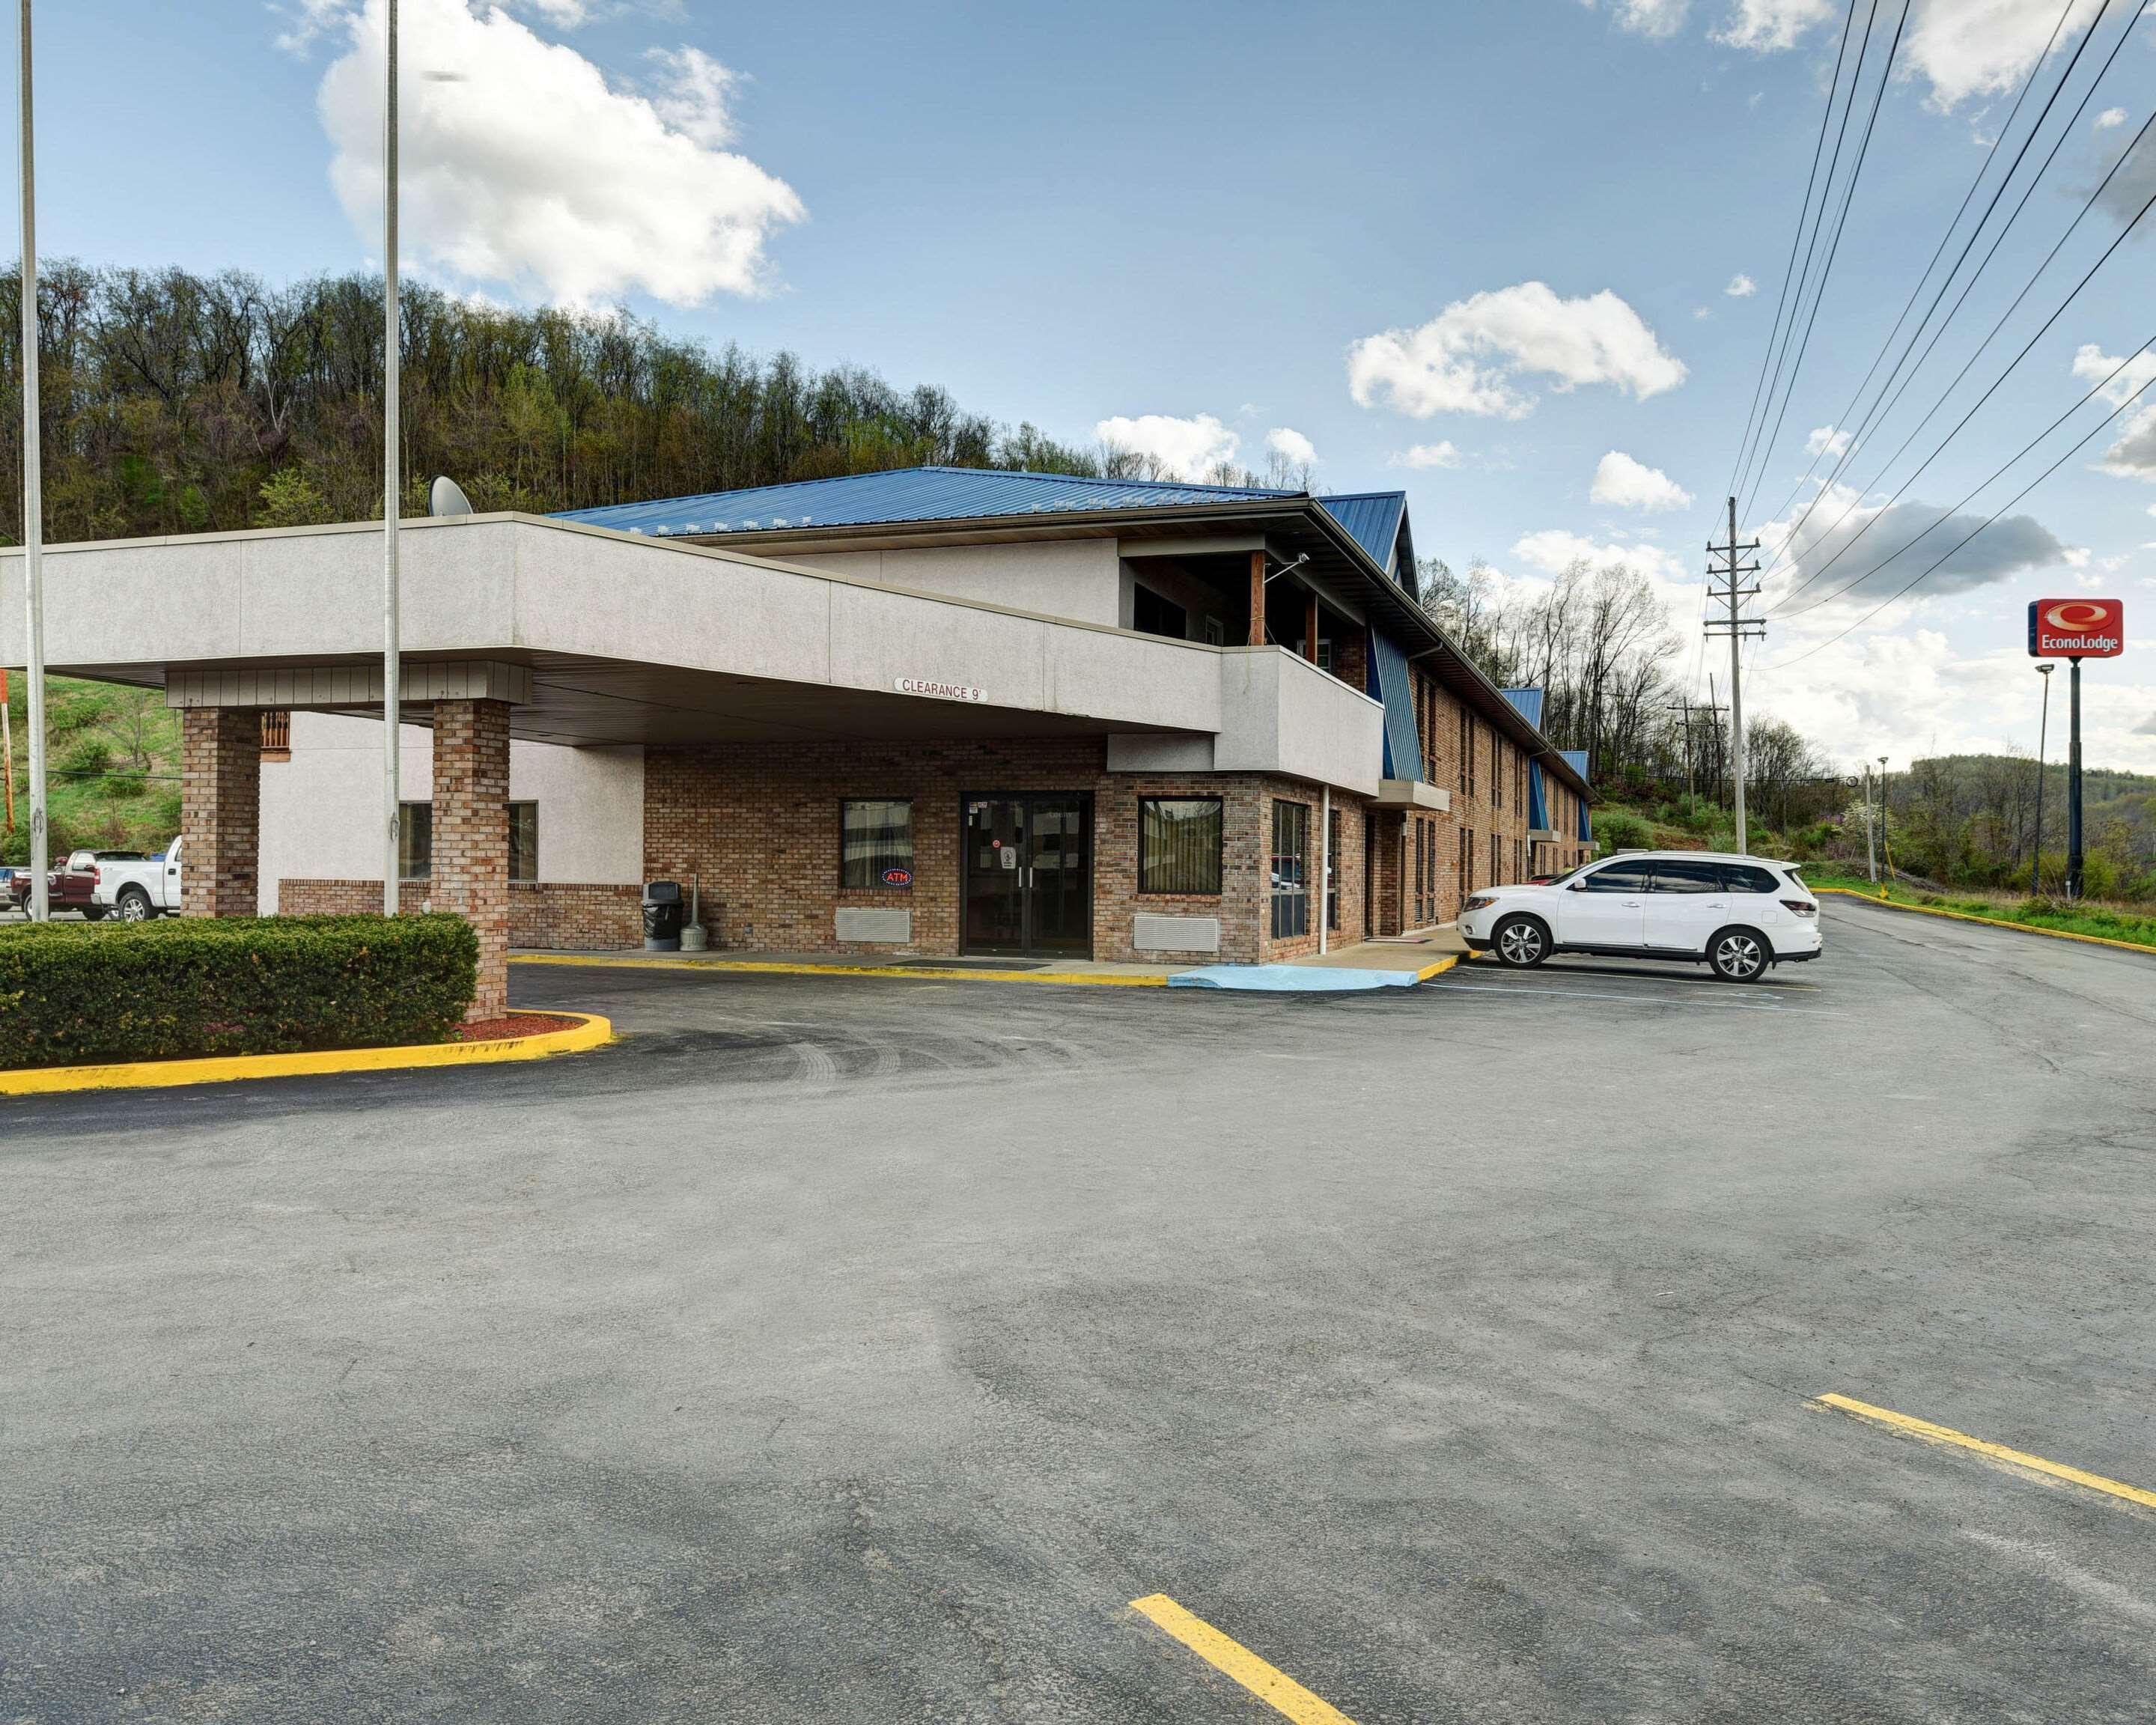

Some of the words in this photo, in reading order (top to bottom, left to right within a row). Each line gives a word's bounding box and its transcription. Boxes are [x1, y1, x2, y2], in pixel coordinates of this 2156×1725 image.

[2041, 634, 2118, 652] EconoLodge
[902, 679, 967, 699] CLEARANCE
[886, 872, 908, 882] ATM
